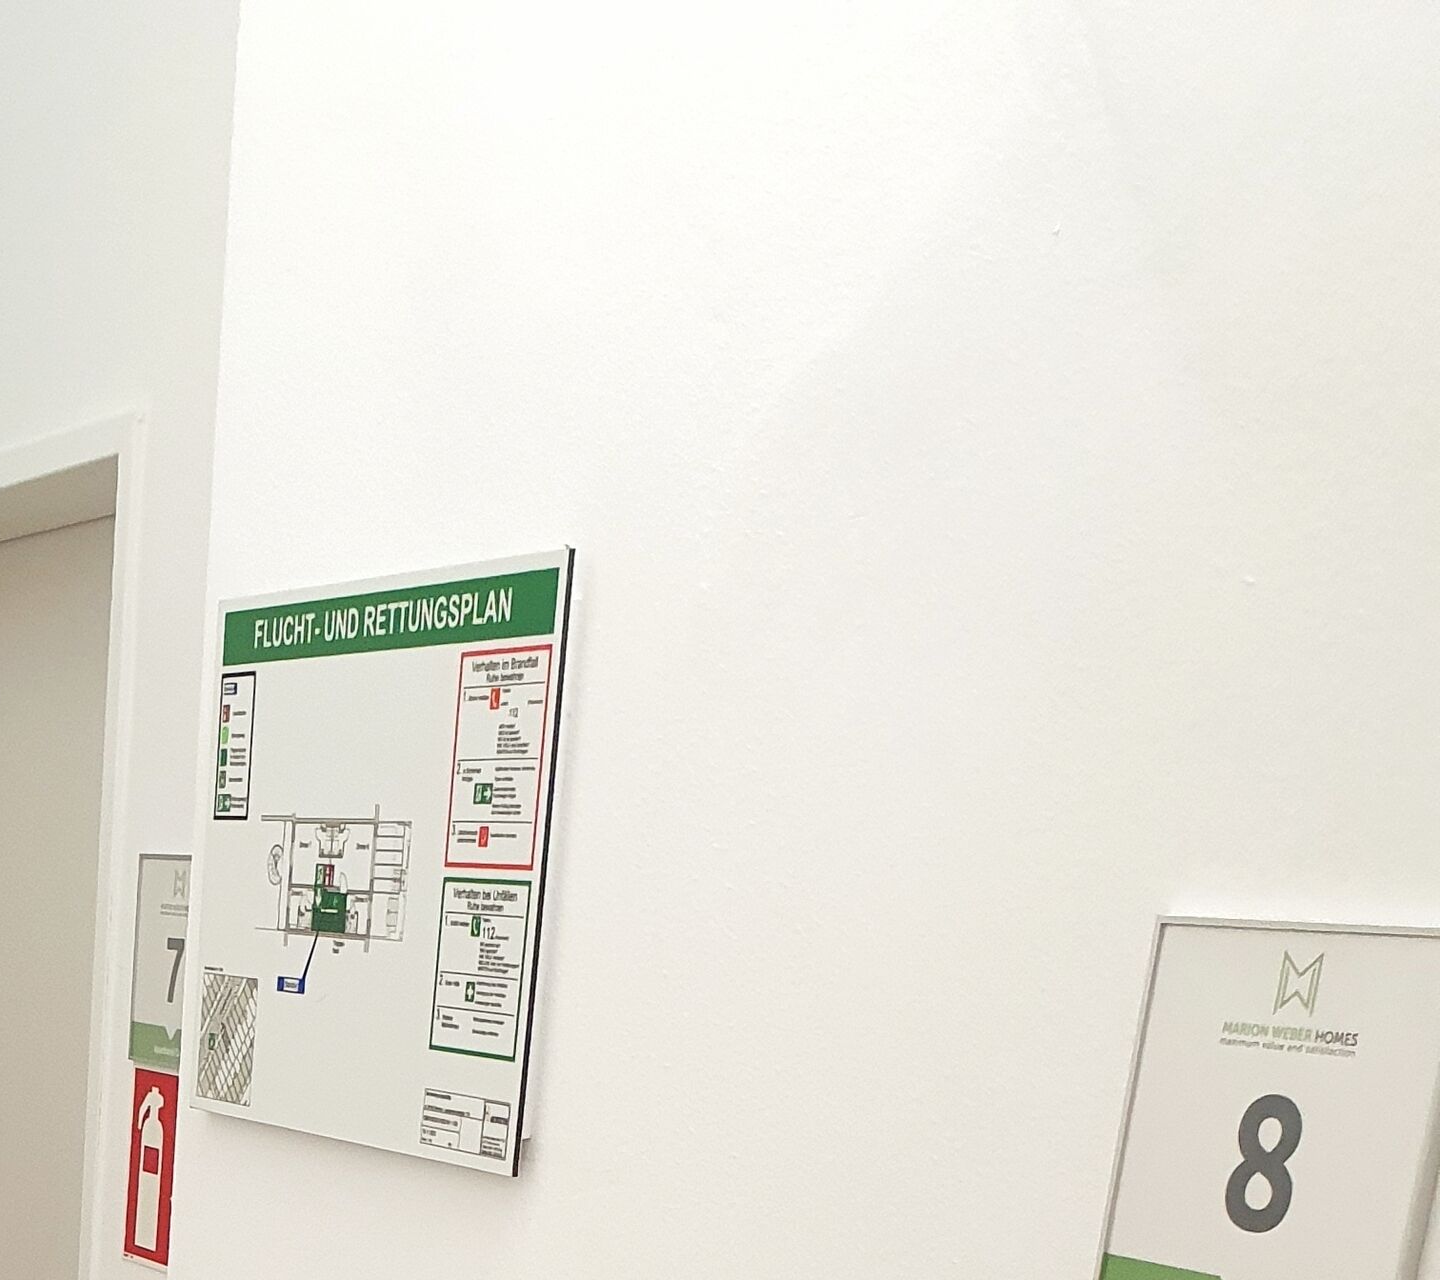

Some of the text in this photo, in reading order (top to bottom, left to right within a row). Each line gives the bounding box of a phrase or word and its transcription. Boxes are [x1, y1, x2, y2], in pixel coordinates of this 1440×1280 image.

[253, 586, 513, 649] FLUCHT- UND RETTUNGSPLAN
[482, 926, 495, 940] 112
[167, 937, 185, 1003] 7
[1222, 1021, 1359, 1047] MARION WEBER HOMES
[1225, 1094, 1303, 1234] 8
